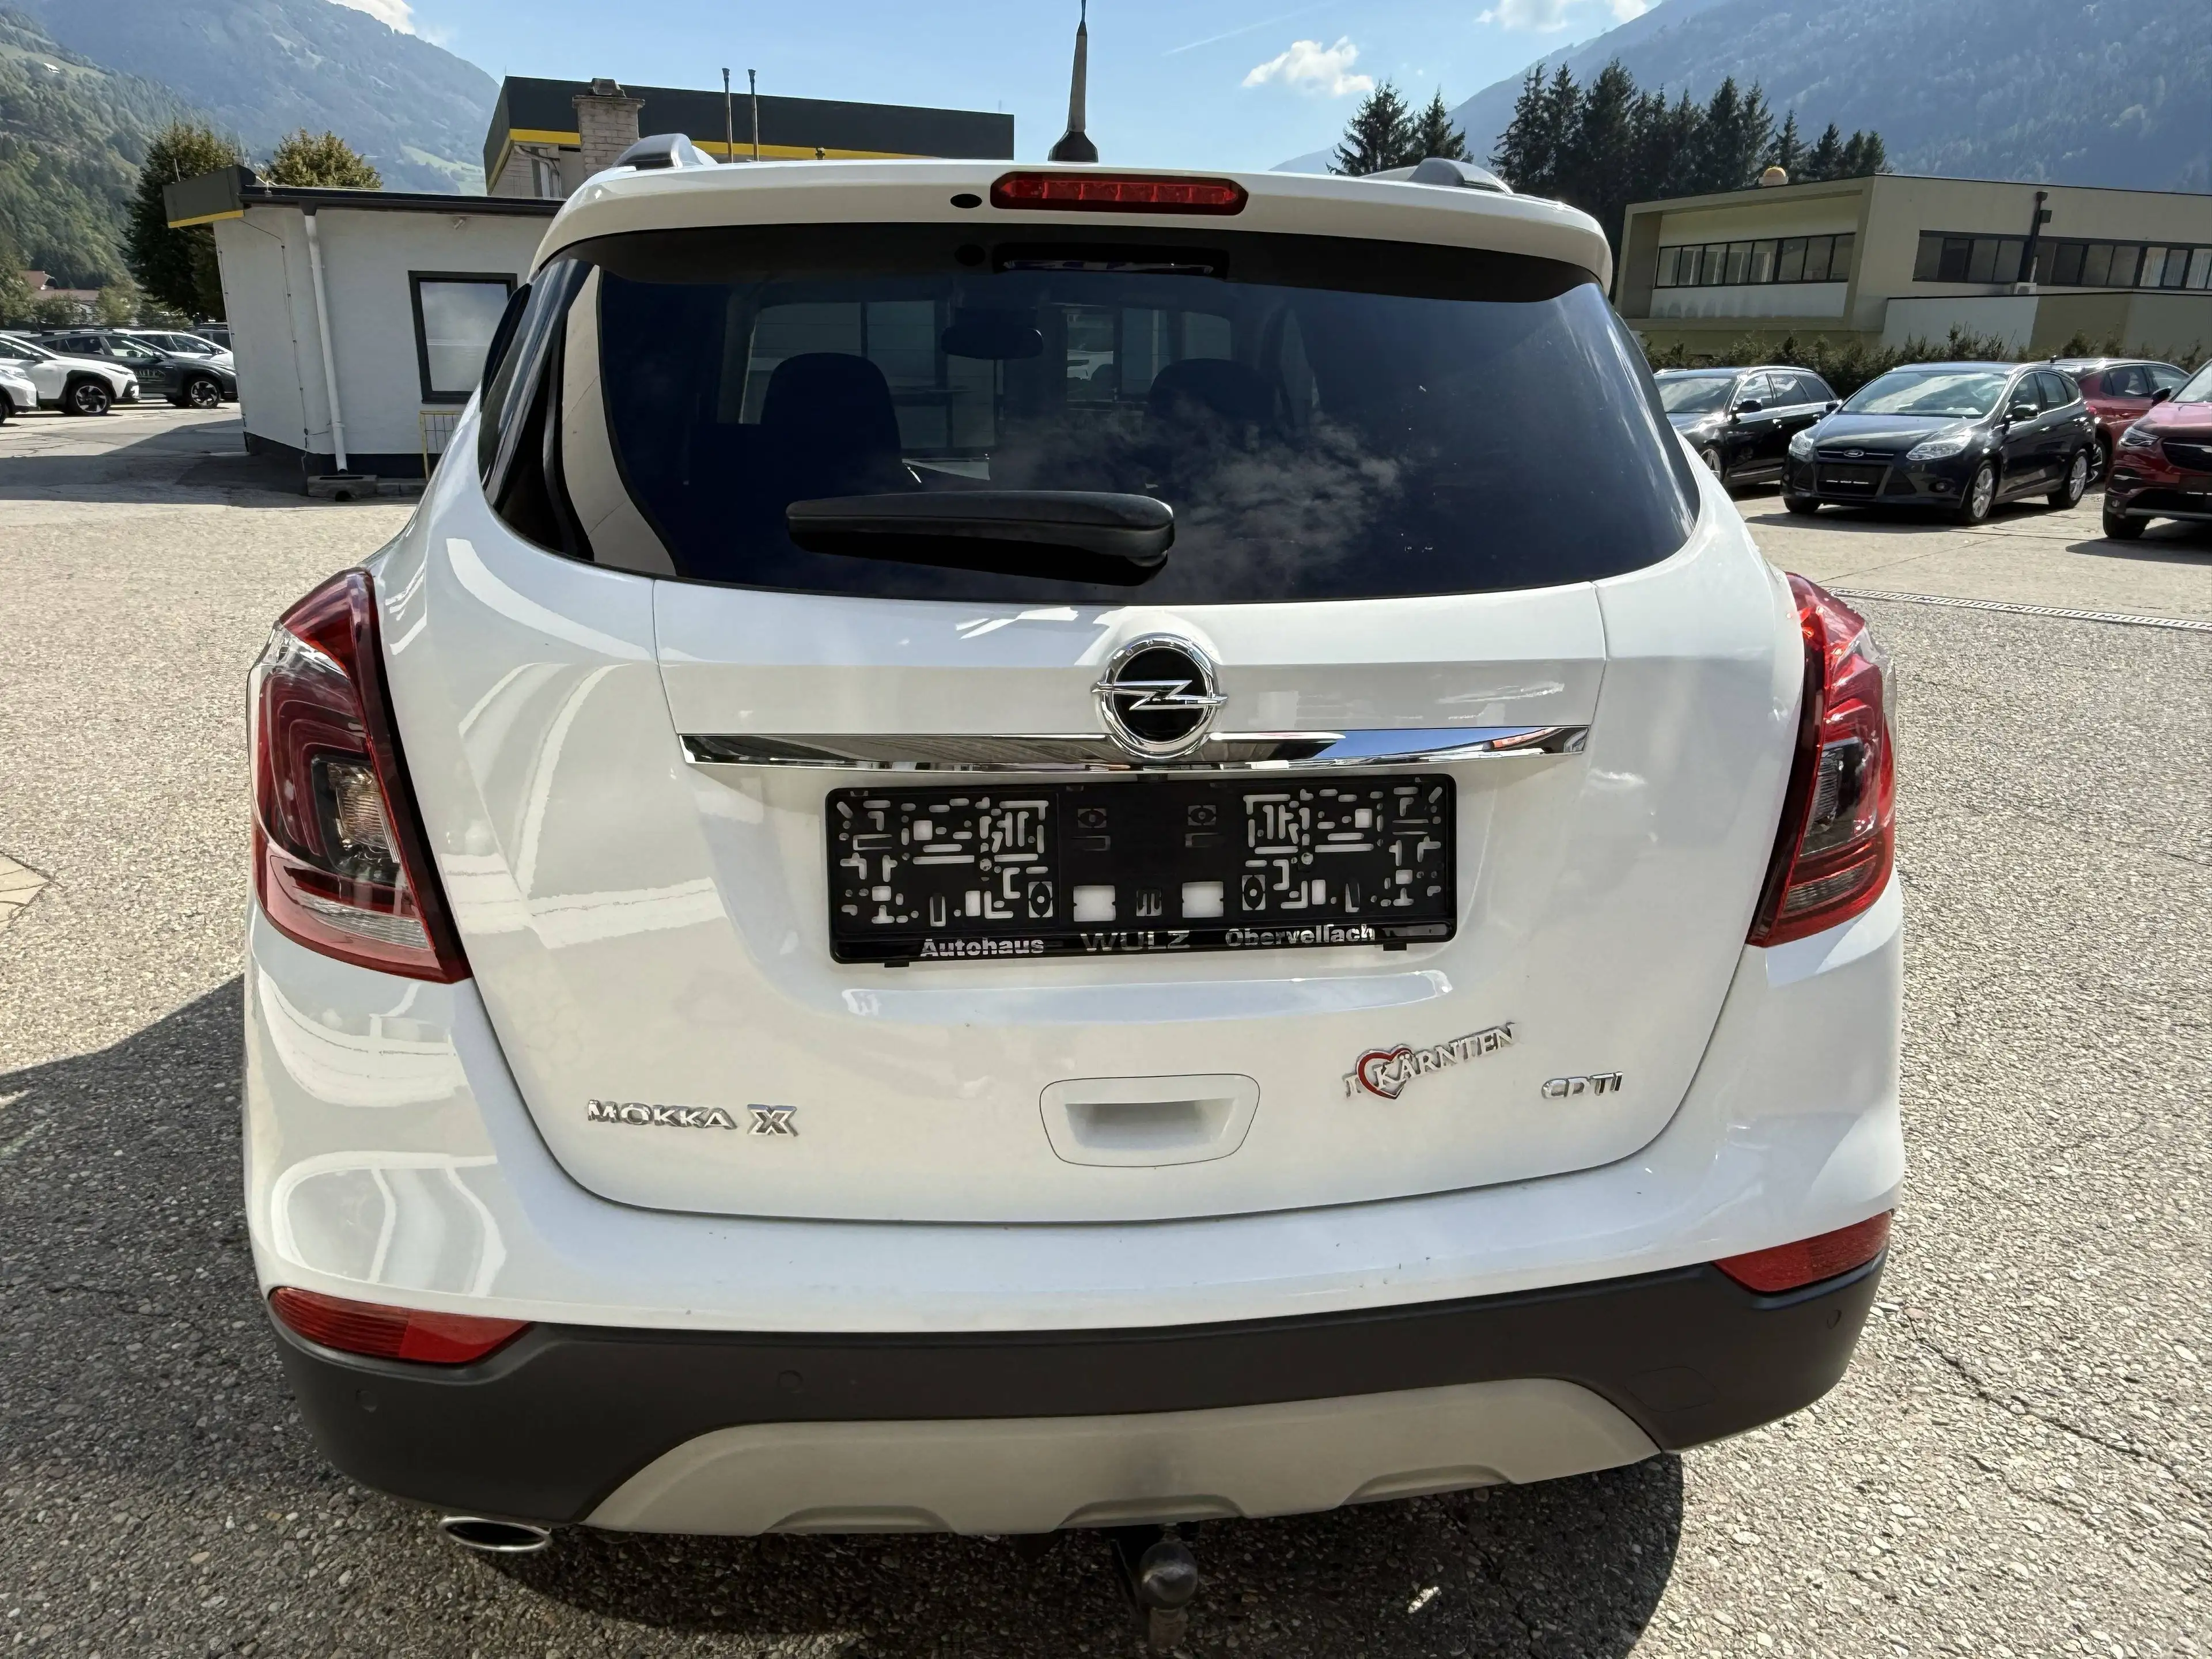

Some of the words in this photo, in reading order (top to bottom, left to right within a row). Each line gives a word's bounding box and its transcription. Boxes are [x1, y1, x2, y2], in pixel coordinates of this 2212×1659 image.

[920, 937, 1044, 957] Autohaus
[1080, 930, 1191, 952] WULZ
[1225, 923, 1376, 946] Obervellach
[1373, 1022, 1521, 1089] KÄRNTEN
[1541, 1071, 1623, 1099] CDTI
[587, 1099, 738, 1130] MOKKA
[747, 1103, 799, 1138] X
